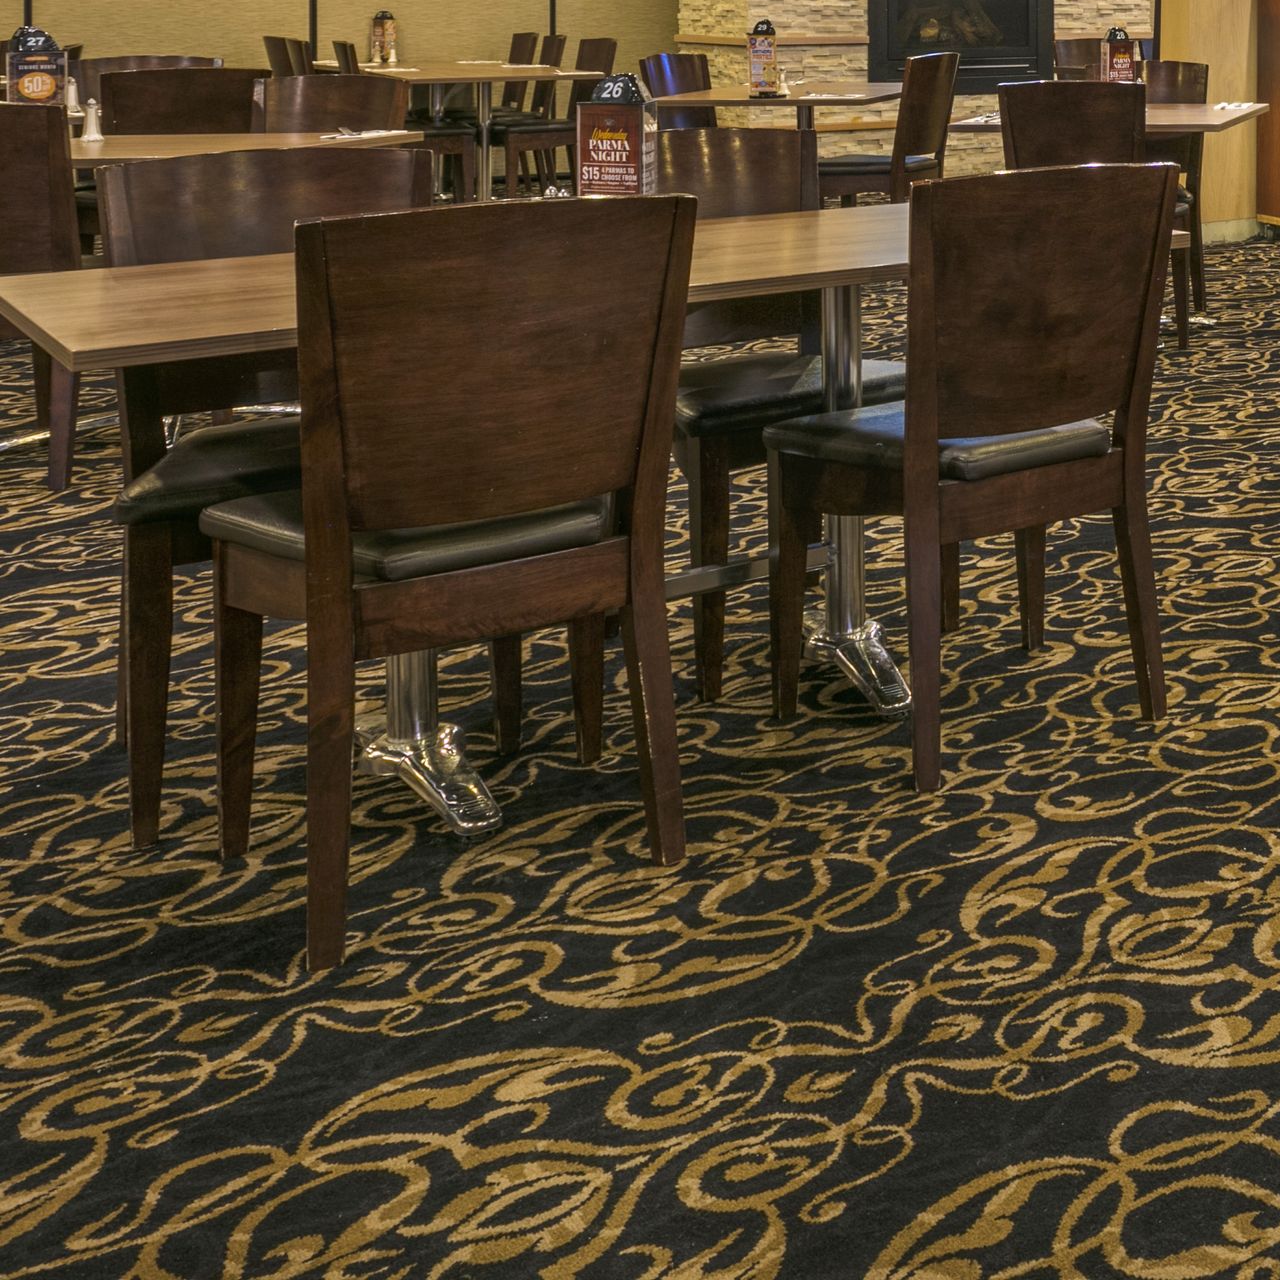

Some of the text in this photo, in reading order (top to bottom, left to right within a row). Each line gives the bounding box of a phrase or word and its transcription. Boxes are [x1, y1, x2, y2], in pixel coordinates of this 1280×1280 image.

[26, 37, 46, 46] 27
[1115, 31, 1126, 40] 28
[601, 82, 623, 98] 26
[588, 139, 630, 151] PARMA
[590, 150, 629, 162] NIGHT
[582, 166, 600, 180] $15
